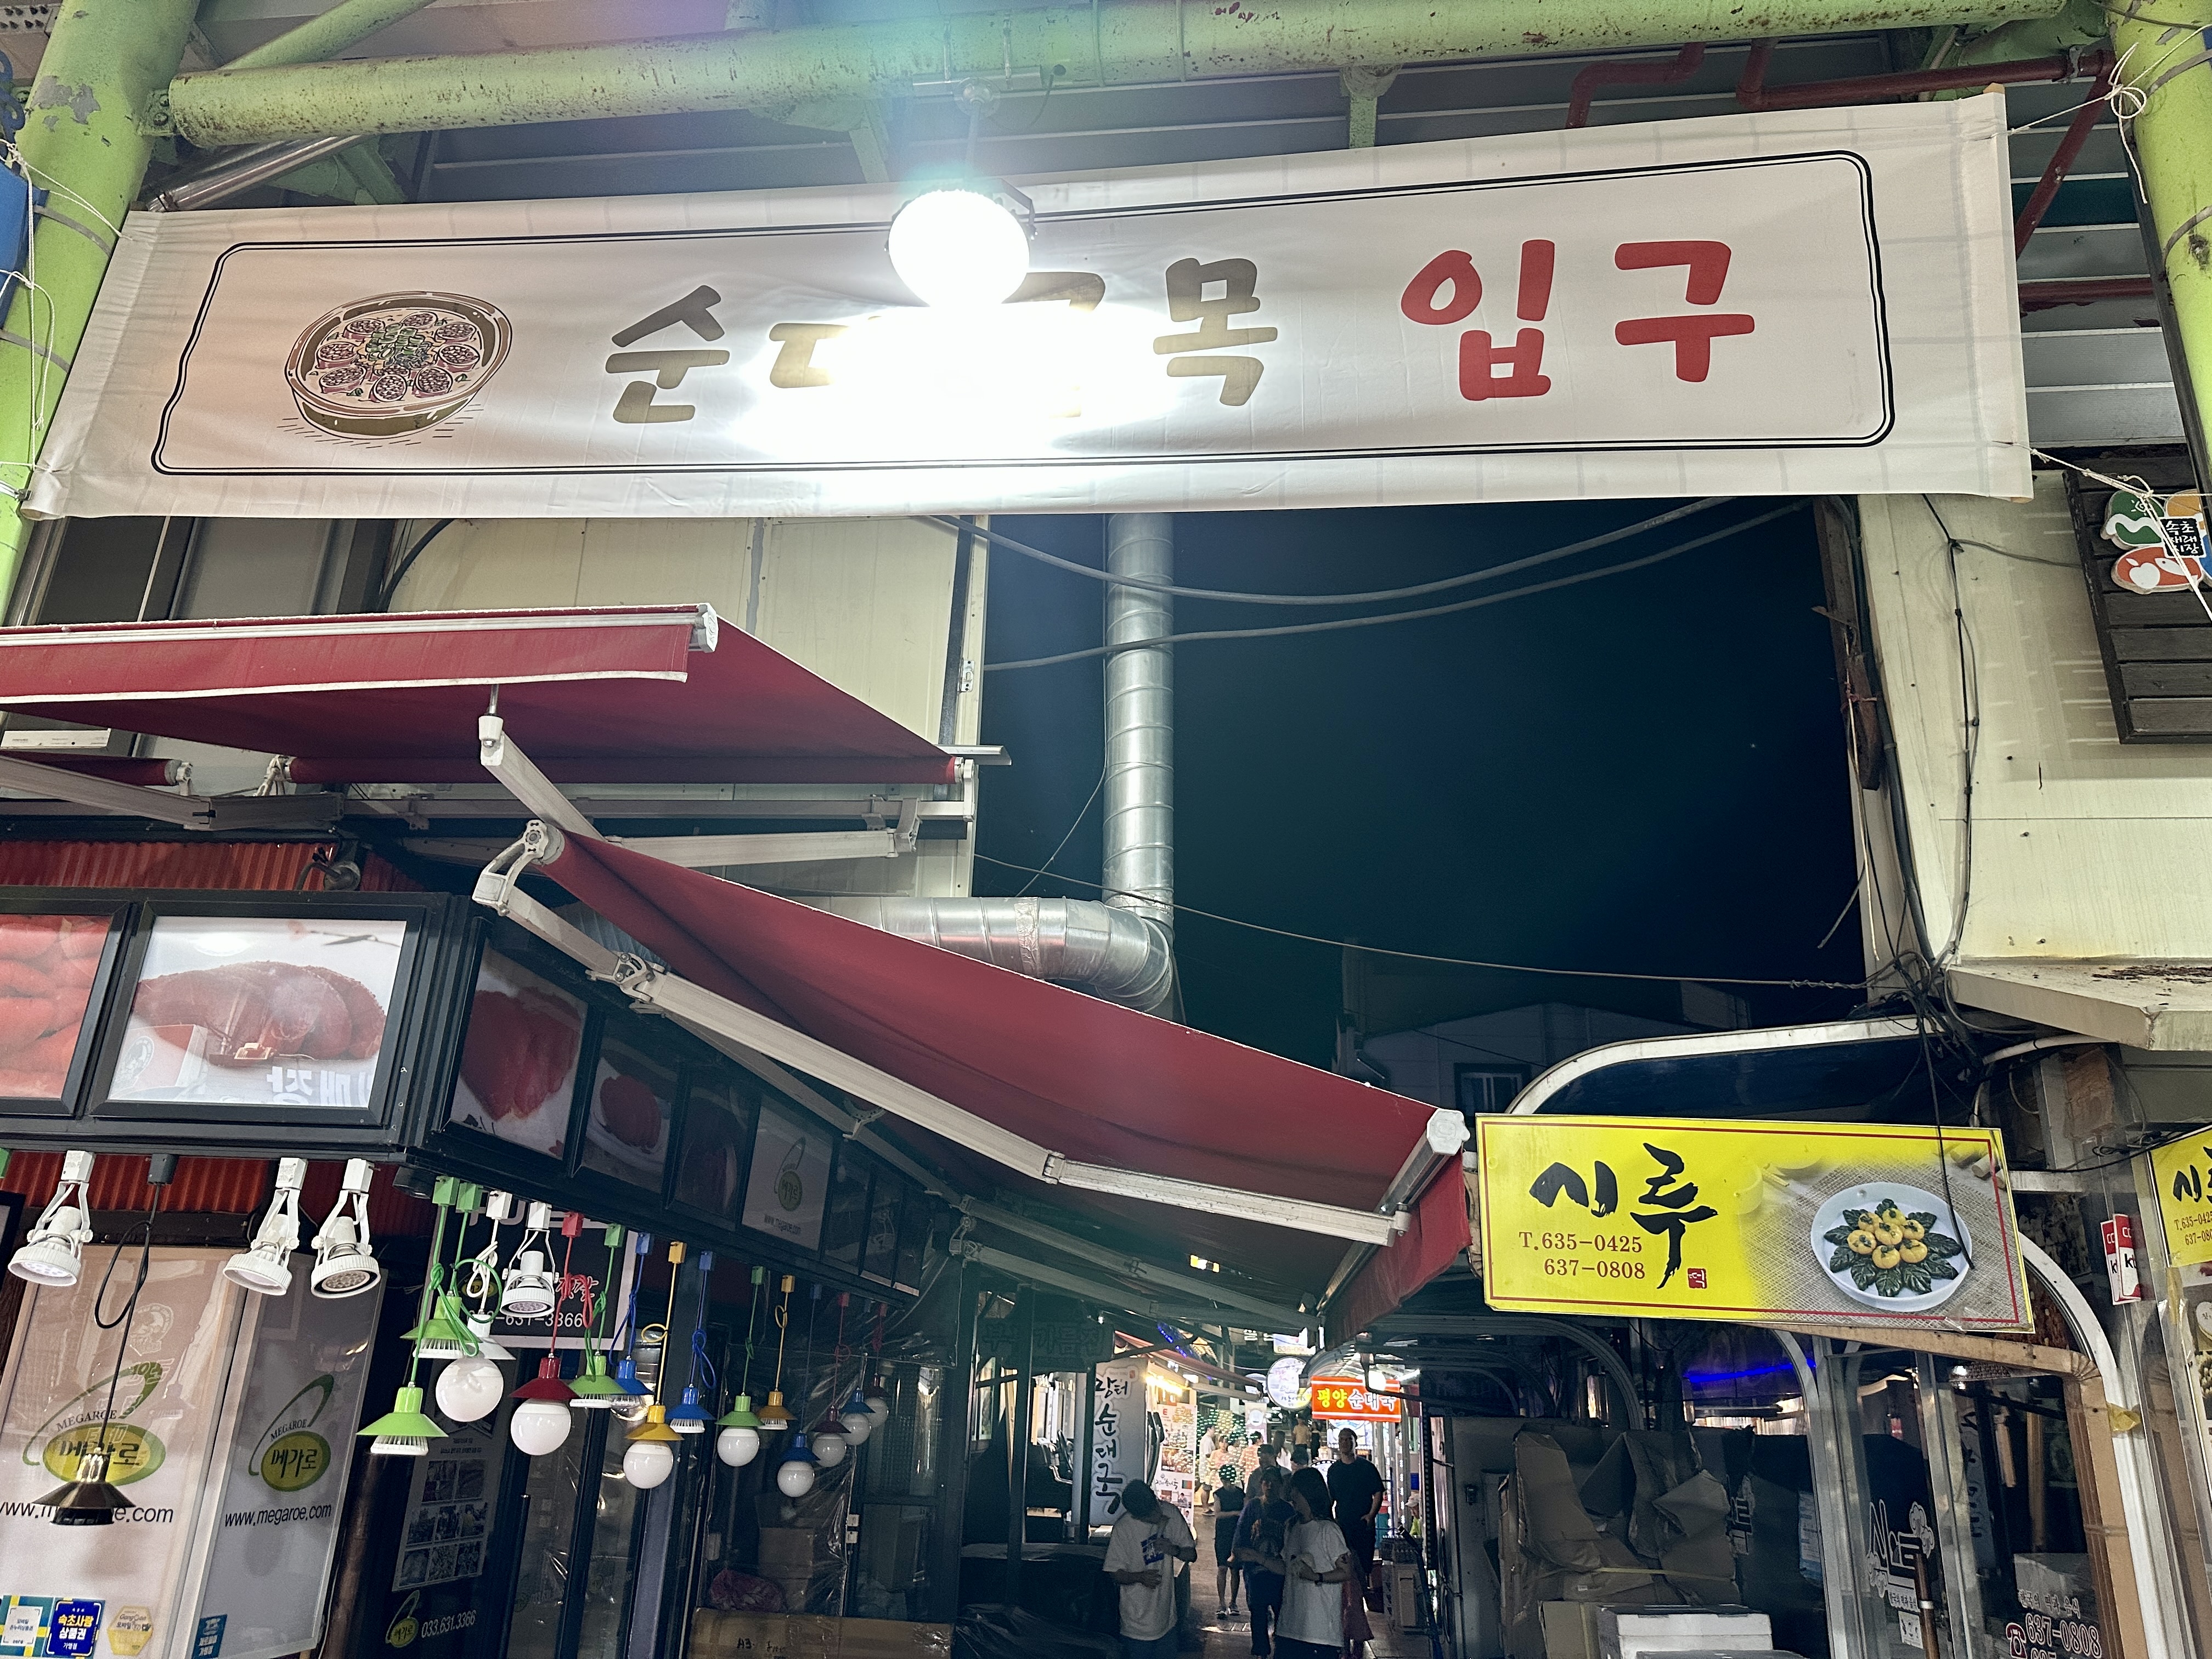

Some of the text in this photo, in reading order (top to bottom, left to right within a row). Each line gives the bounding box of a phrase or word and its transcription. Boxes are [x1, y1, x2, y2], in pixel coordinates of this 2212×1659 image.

[1400, 237, 1756, 402] 입구
[2166, 520, 2195, 535] 속초
[1529, 1142, 1719, 1289] 시루
[1519, 1231, 1643, 1253] T.635-0425
[1544, 1258, 1645, 1279] 637-0808
[270, 1419, 308, 1442] MEGAROE
[270, 1448, 318, 1479] 메가로
[1094, 1403, 1123, 1515] 순대국
[224, 1504, 332, 1527] www.megaroe.com
[58, 1614, 94, 1628] 속초사랑
[421, 1609, 477, 1639] 033.631.3366
[59, 1627, 87, 1640] 상품권
[2025, 1612, 2102, 1658] 637-0808
